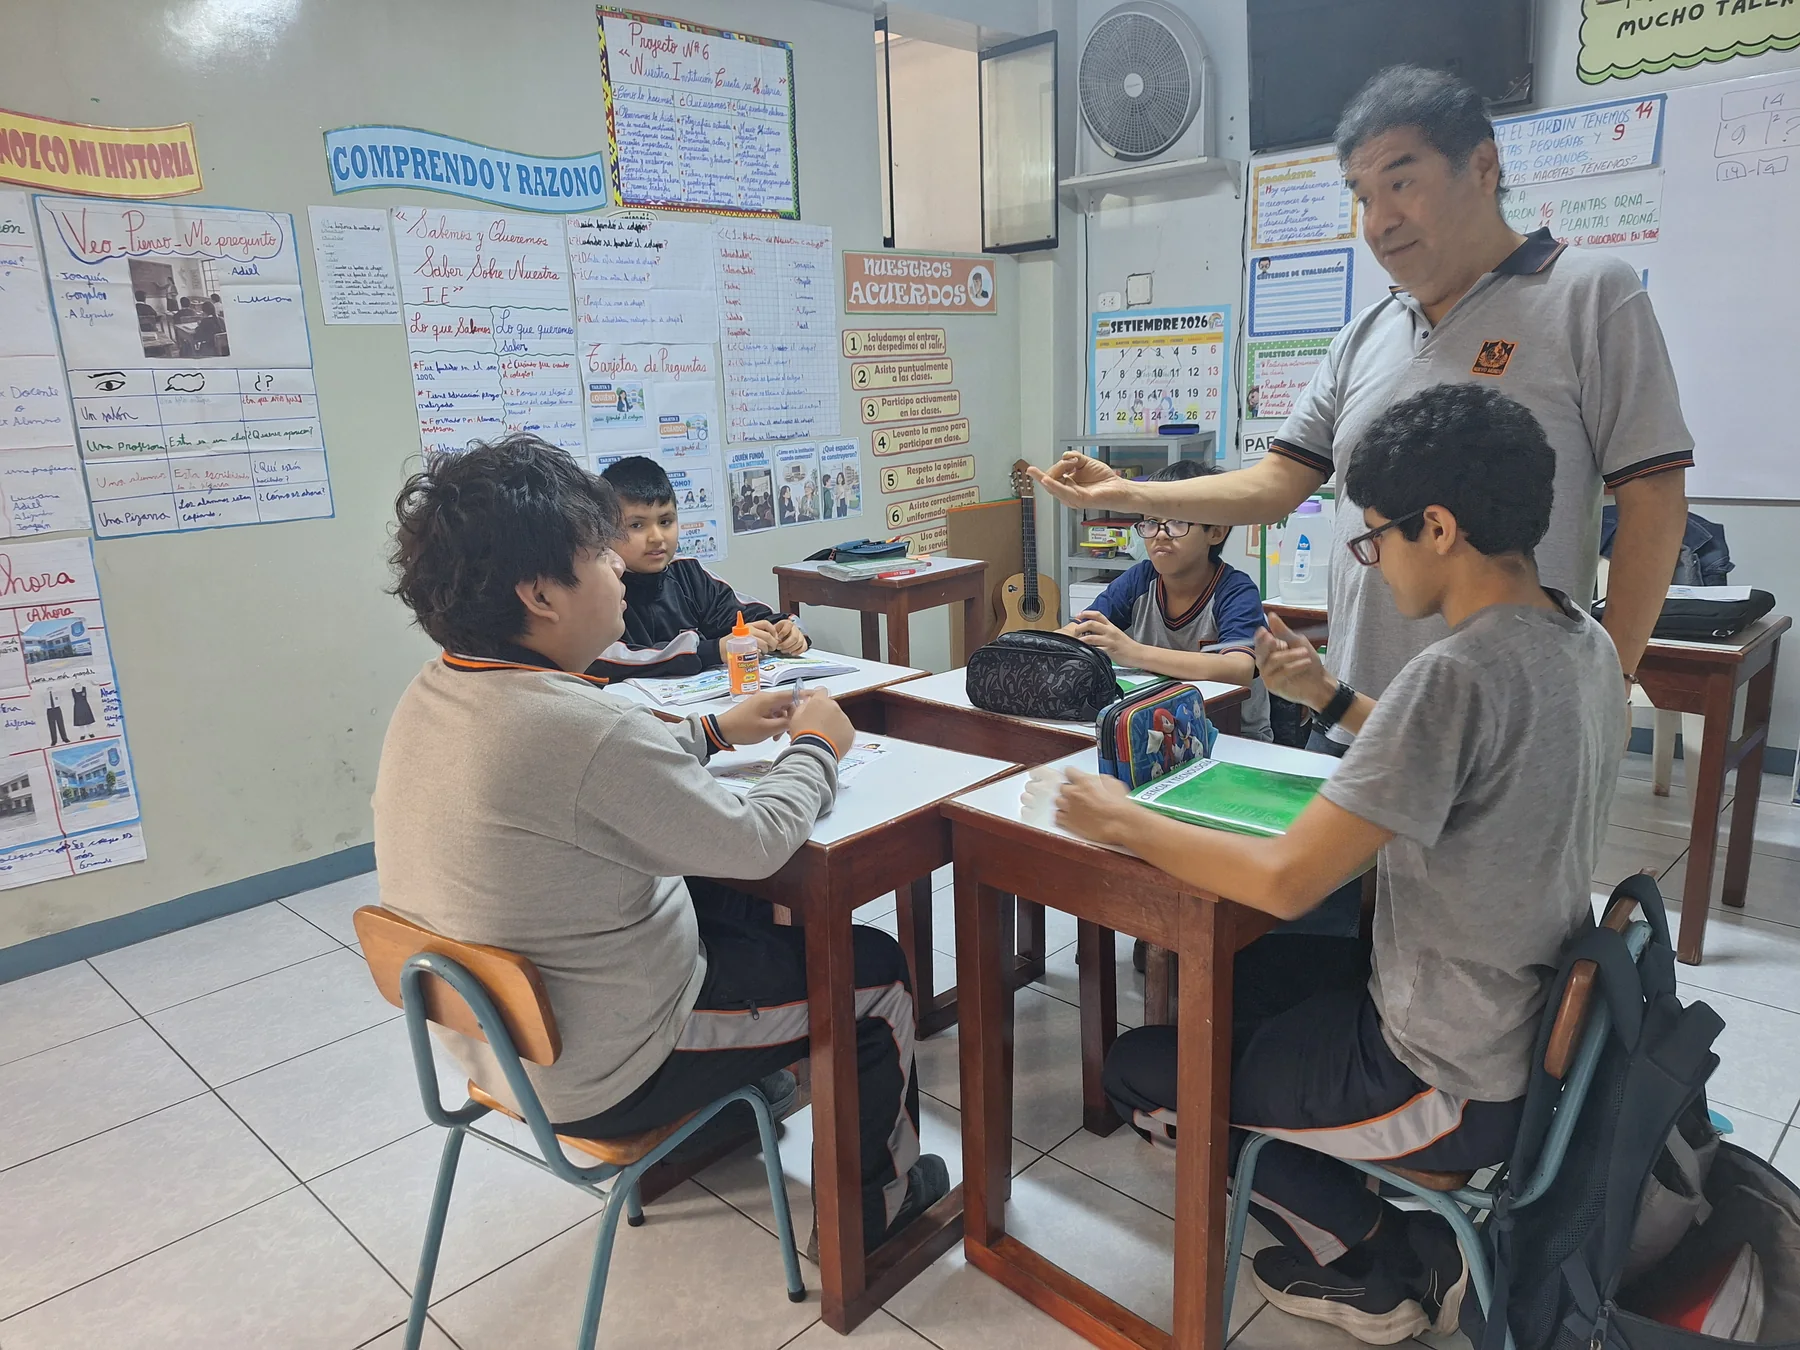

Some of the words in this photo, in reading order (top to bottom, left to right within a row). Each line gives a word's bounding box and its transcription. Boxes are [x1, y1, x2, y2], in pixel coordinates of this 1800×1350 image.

[1616, 4, 1705, 39] MUCHO
[628, 21, 678, 58] Proyecto
[630, 52, 672, 80] Nuestra
[1762, 92, 1785, 110] 14
[1510, 124, 1522, 141] EL
[1528, 116, 1577, 139] JARDIN
[1582, 109, 1631, 129] TENEMOS
[1635, 101, 1653, 120] 14
[1528, 134, 1585, 154] PEQUEÑAS
[1612, 123, 1625, 141] 9
[0, 128, 70, 175] NOZCO
[68, 138, 101, 178] MI
[98, 141, 195, 180] HISTORIA
[1533, 151, 1593, 169] GRANDES.
[332, 144, 495, 190] COMPRENDO
[496, 160, 511, 193] Y
[517, 163, 602, 198] RAZONO
[1532, 166, 1574, 182] MACETAS
[1580, 155, 1638, 174] TENEMOS?
[1265, 185, 1279, 198] Hoy
[1280, 180, 1331, 194] aprenderemos
[1265, 198, 1300, 209] reconocer
[1301, 194, 1311, 205] lo
[1311, 194, 1326, 205] que
[1540, 201, 1554, 219] 16
[1560, 195, 1607, 215] PLANTAS
[407, 208, 472, 241] Sabemos
[475, 231, 485, 252] y
[488, 218, 549, 247] Queremos
[1263, 214, 1319, 228] descubriremos
[1263, 226, 1298, 236] maneras
[1299, 221, 1334, 232] adecuadas
[1559, 215, 1610, 233] PLANTAS
[61, 207, 112, 255] Veo
[122, 209, 171, 252] Pienso
[184, 218, 212, 248] Me
[215, 230, 277, 255] pregunto
[1264, 234, 1274, 243] de
[1275, 231, 1328, 242] expresarlo.
[1587, 232, 1627, 246] COLOCARON
[1630, 231, 1641, 241] EN
[414, 245, 465, 278] Saber
[466, 254, 504, 281] Sobre
[509, 255, 561, 281] Nuestra
[863, 258, 952, 278] NUESTROS
[1256, 271, 1290, 281] CRITERIOS
[1291, 270, 1300, 278] DE
[1301, 261, 1345, 277] EVALUACIÓN
[849, 280, 967, 306] ACUERDOS
[410, 314, 429, 334] Lo
[432, 324, 454, 341] que
[455, 316, 492, 338] Sabemos
[496, 309, 514, 334] Lo
[516, 321, 535, 340] que
[537, 324, 574, 340] queremos
[1110, 316, 1179, 334] SETIEMBRE
[1180, 314, 1208, 330] 2026
[850, 337, 858, 351] 1
[867, 332, 907, 343] Saludamos
[908, 332, 916, 342] al
[916, 333, 941, 343] entrar,
[863, 343, 876, 352] nos
[877, 341, 919, 353] despedimos
[919, 340, 928, 350] al
[928, 339, 945, 350] salir.
[1137, 348, 1143, 357] 2
[1155, 347, 1161, 356] 3
[1191, 346, 1197, 355] 5
[1210, 345, 1217, 354] 6
[586, 343, 639, 382] Tarjetas
[644, 355, 658, 374] de
[657, 347, 708, 382] Preguntas
[1258, 349, 1296, 358] NUESTROS
[857, 370, 867, 384] 2
[874, 365, 896, 375] Asisto
[898, 362, 949, 375] puntualmente
[898, 373, 909, 382] las
[910, 372, 933, 382] clases.
[1101, 370, 1107, 380] 7
[1119, 369, 1125, 379] 8
[1136, 369, 1142, 378] 9
[1152, 368, 1163, 378] 10
[1170, 367, 1180, 377] 11
[1188, 367, 1200, 376] 12
[1207, 366, 1219, 376] 13
[10, 385, 59, 399] Docente
[1100, 391, 1110, 400] 14
[1117, 390, 1127, 400] 15
[1134, 390, 1144, 399] 16
[1152, 389, 1162, 398] 17
[1169, 388, 1180, 398] 18
[1187, 388, 1199, 398] 19
[1206, 387, 1218, 397] 20
[80, 406, 98, 421] Un
[867, 403, 875, 418] 3
[881, 396, 914, 408] Participo
[915, 393, 958, 405] activamente
[909, 407, 920, 417] las
[920, 405, 942, 416] clases.
[1099, 412, 1110, 421] 21
[1116, 412, 1127, 421] 22
[1133, 411, 1144, 421] 23
[1151, 411, 1162, 420] 24
[1168, 411, 1179, 420] 25
[1186, 410, 1198, 420] 26
[1205, 410, 1217, 420] 27
[877, 436, 887, 450] 4
[892, 427, 921, 439] Levanto
[921, 426, 929, 435] la
[930, 424, 949, 434] mano
[950, 421, 966, 432] para
[898, 437, 933, 451] participar
[934, 436, 943, 444] en
[943, 432, 961, 443] clase.
[86, 439, 113, 452] Una
[822, 444, 835, 455] ¿Qué
[835, 443, 855, 453] espacios
[748, 451, 765, 460] FUNDÓ
[887, 473, 895, 488] 5
[906, 465, 933, 477] Respeto
[934, 462, 942, 472] la
[943, 459, 967, 471] opinión
[916, 476, 925, 486] de
[925, 474, 935, 484] los
[936, 471, 960, 483] demás.
[891, 509, 900, 523] 6
[908, 500, 930, 512] Asisto
[930, 489, 976, 508] correctamente
[906, 508, 946, 523] uniformado
[124, 512, 171, 528] Pizarra
[920, 531, 933, 541] Uso
[918, 544, 928, 553] los
[27, 604, 75, 623] Ahora
[1140, 782, 1170, 801] CIENCIA
